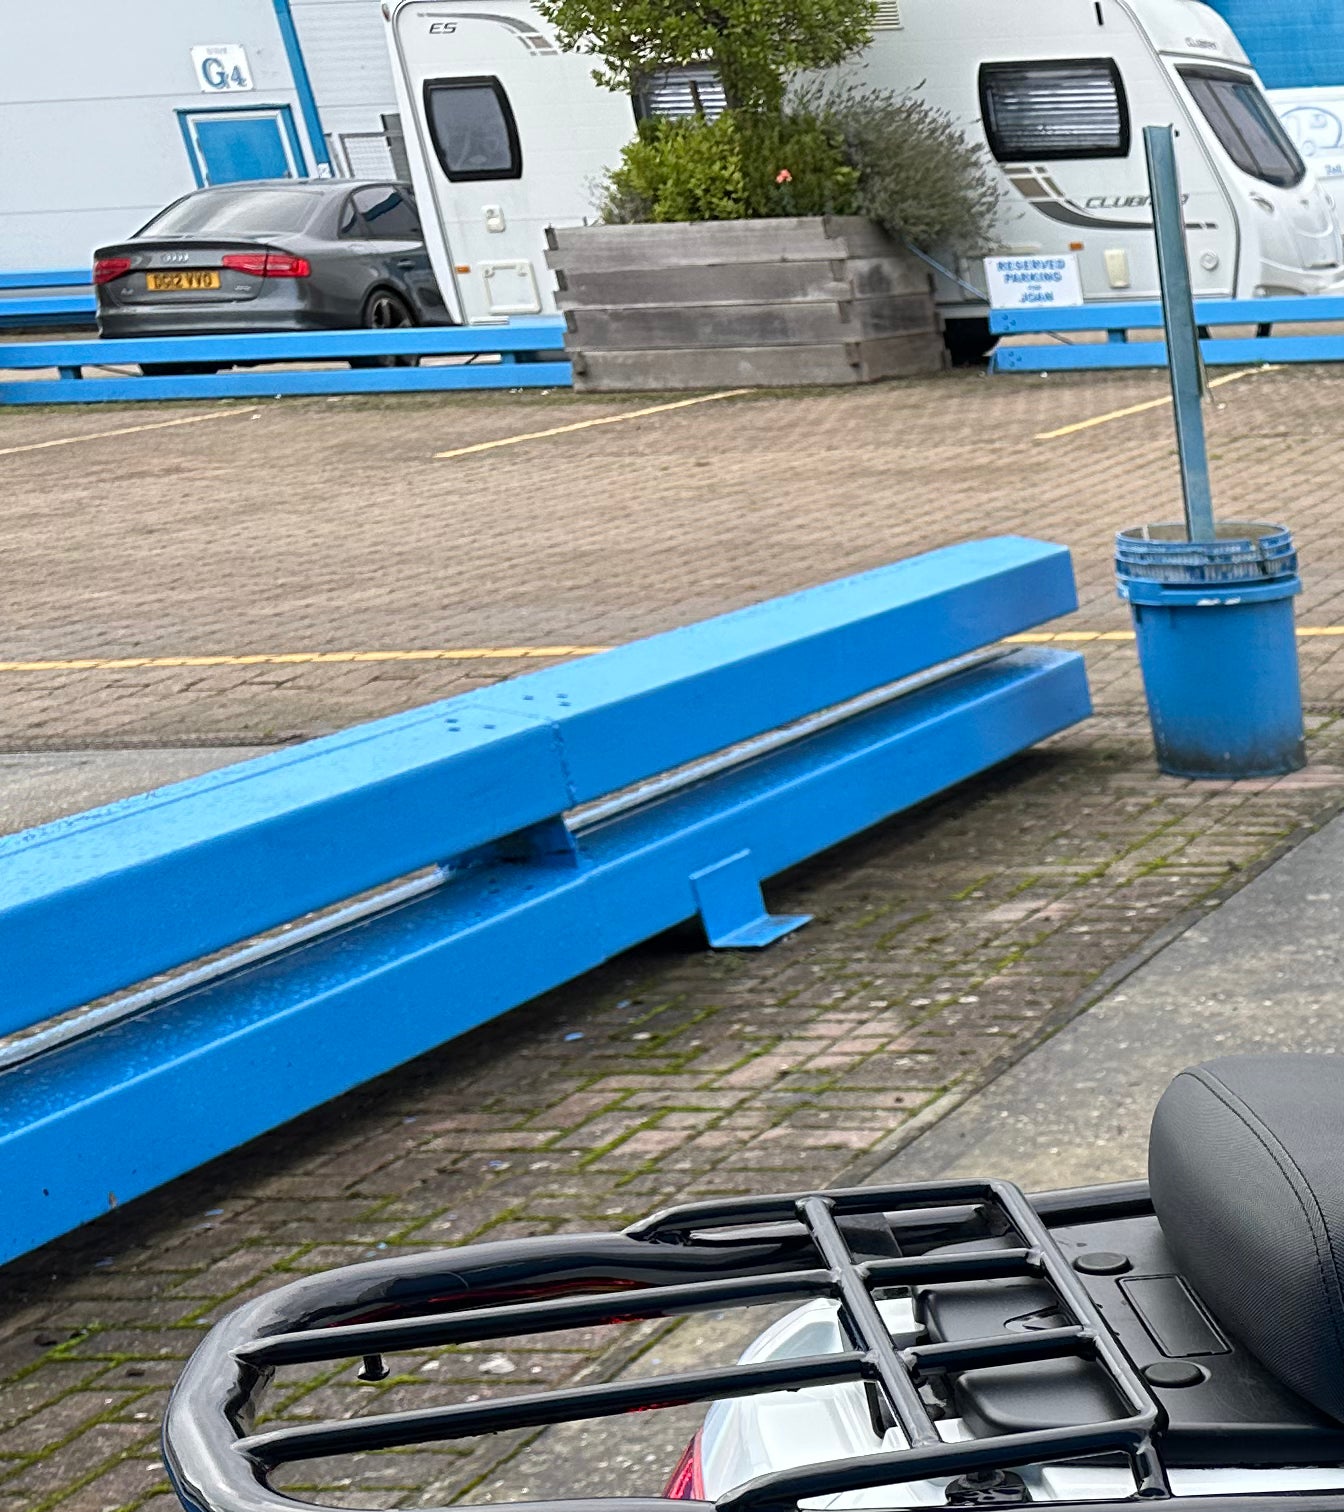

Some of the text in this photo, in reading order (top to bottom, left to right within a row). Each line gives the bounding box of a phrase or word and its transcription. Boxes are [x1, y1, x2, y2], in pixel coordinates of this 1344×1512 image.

[429, 22, 458, 34] ES
[202, 57, 247, 89] G4
[997, 259, 1065, 272] RESERVED
[1004, 272, 1062, 284] PARKING
